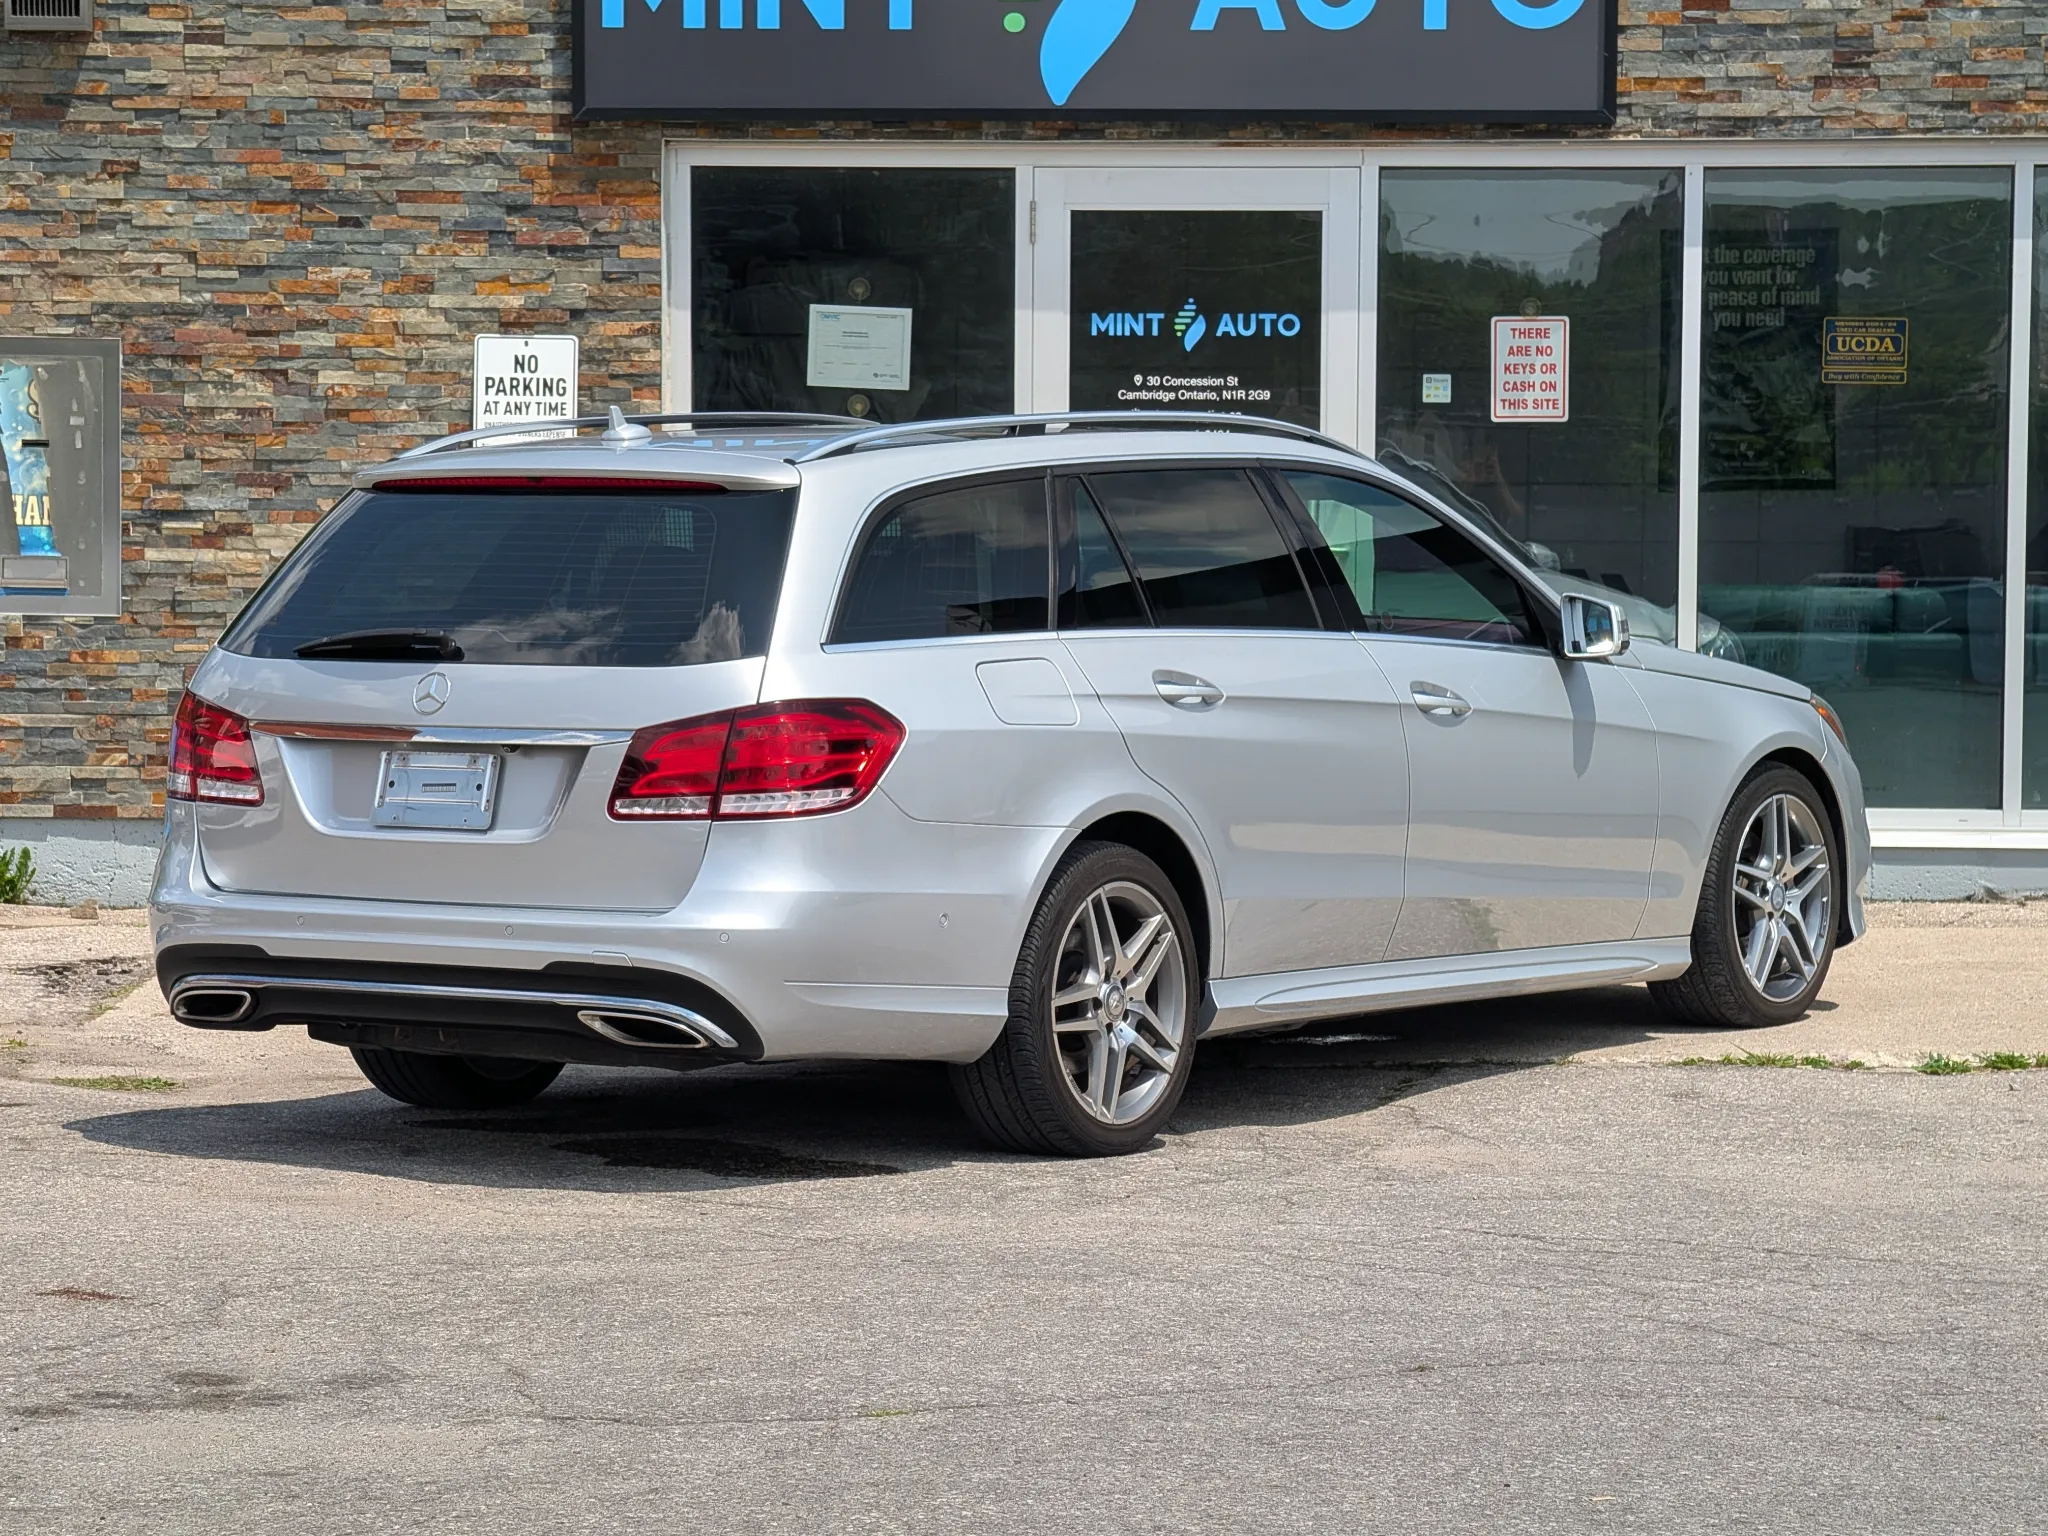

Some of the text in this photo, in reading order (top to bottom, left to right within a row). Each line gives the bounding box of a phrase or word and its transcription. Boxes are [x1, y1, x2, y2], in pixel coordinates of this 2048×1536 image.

[1714, 244, 1740, 264] the
[1743, 248, 1816, 269] coverage
[1732, 269, 1772, 285] want
[1776, 265, 1798, 285] for
[1708, 284, 1821, 310] peace of mind
[1091, 313, 1300, 336] MINT AUTO
[1713, 307, 1785, 331] you need
[1510, 327, 1551, 339] THERE
[1507, 345, 1553, 357] ARE NO
[1836, 337, 1896, 352] UCDA
[514, 354, 538, 374] NO
[1503, 363, 1557, 375] KEYS OR
[484, 377, 567, 397] PARKING
[1146, 375, 1238, 387] 30 Concession St
[1503, 381, 1557, 392] CASH ON
[1117, 389, 1270, 402] Cambridge Ontario, N1R 2G9
[483, 401, 567, 416] AT ANY TIME
[1500, 398, 1560, 410] THIS SITE
